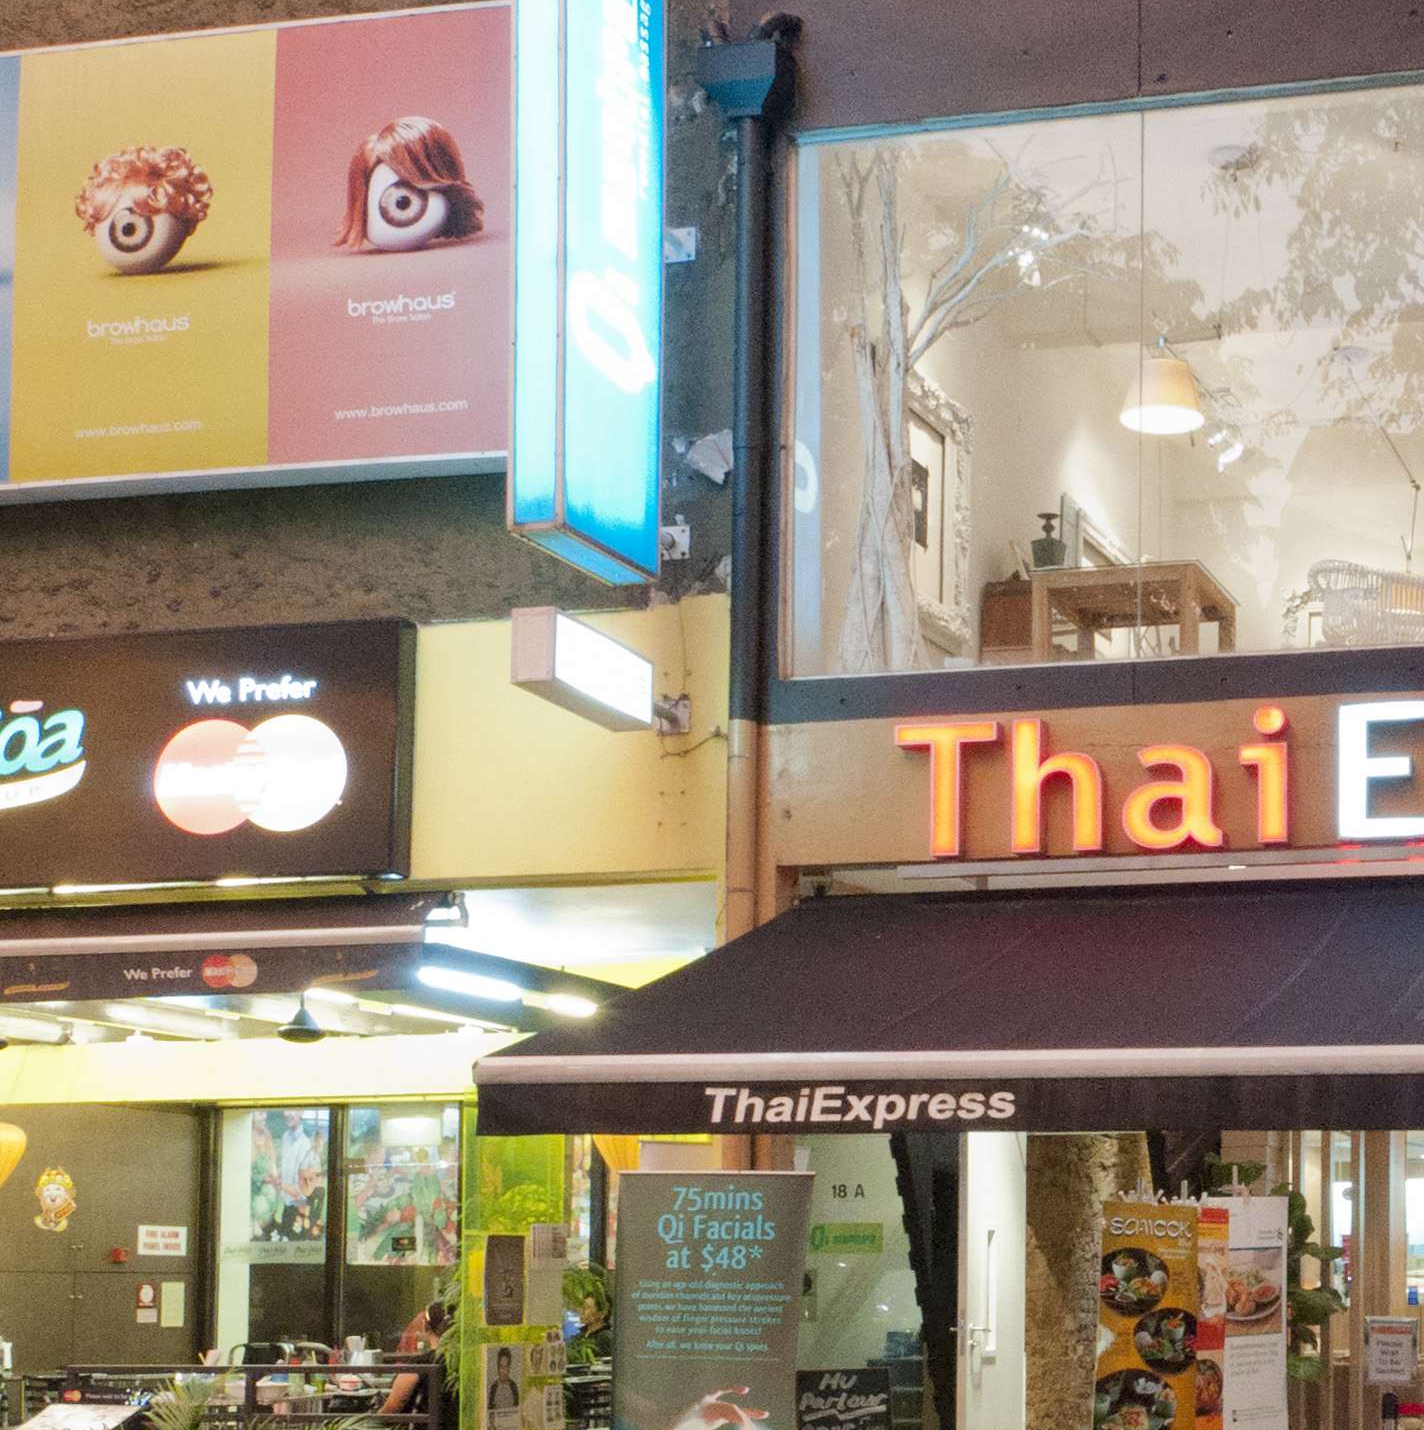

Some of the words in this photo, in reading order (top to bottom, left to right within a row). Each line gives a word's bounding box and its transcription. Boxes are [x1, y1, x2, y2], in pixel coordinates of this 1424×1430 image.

[347, 293, 456, 317] browhaus
[86, 315, 191, 338] browhaus
[334, 399, 469, 420] www.browhaus.com
[74, 420, 203, 438] www.browhaus.com
[186, 678, 232, 705] We
[240, 675, 317, 702] Prefer
[894, 705, 1290, 858] Thai
[123, 968, 148, 980] We
[151, 966, 193, 979] Prefer
[704, 1085, 1017, 1129] ThaiExpress
[672, 1184, 764, 1211] 75mins
[831, 1183, 848, 1199] 18
[854, 1183, 865, 1199] A
[657, 1213, 685, 1244] Qi
[693, 1214, 776, 1240] Facials
[665, 1246, 692, 1269] at
